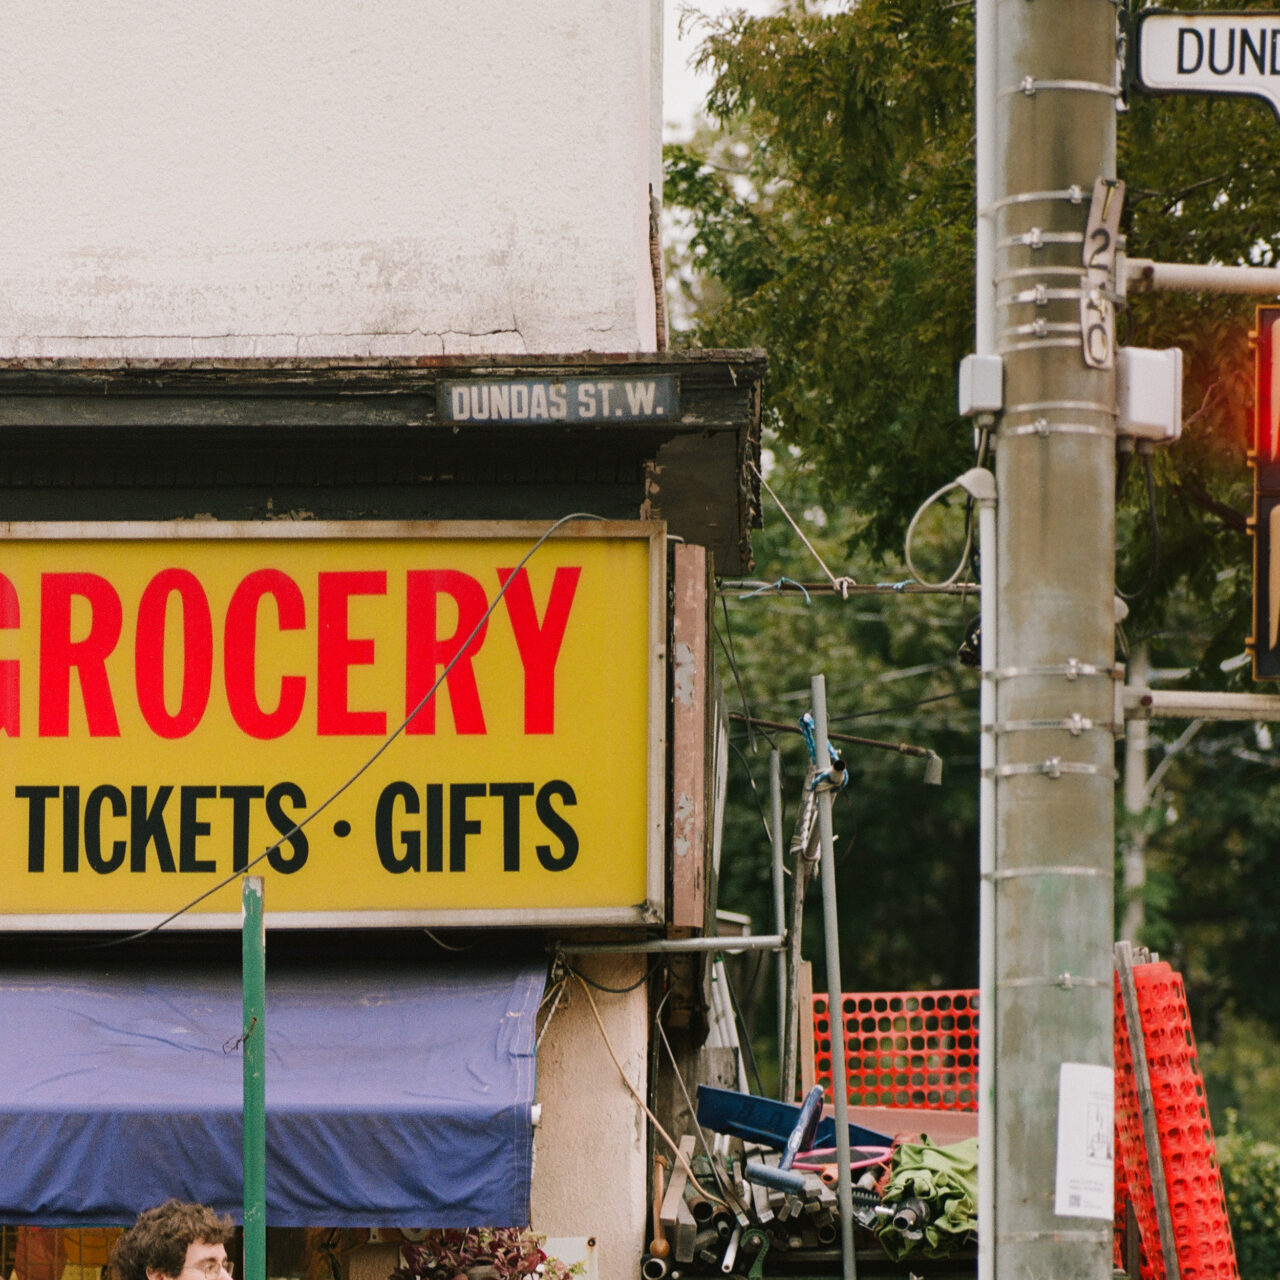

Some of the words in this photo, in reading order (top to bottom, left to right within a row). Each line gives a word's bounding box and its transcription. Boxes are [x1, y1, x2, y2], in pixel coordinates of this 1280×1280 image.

[451, 382, 567, 421] DUNDAS
[15, 780, 310, 875] TICKETS
[375, 779, 580, 874] GIFTS
